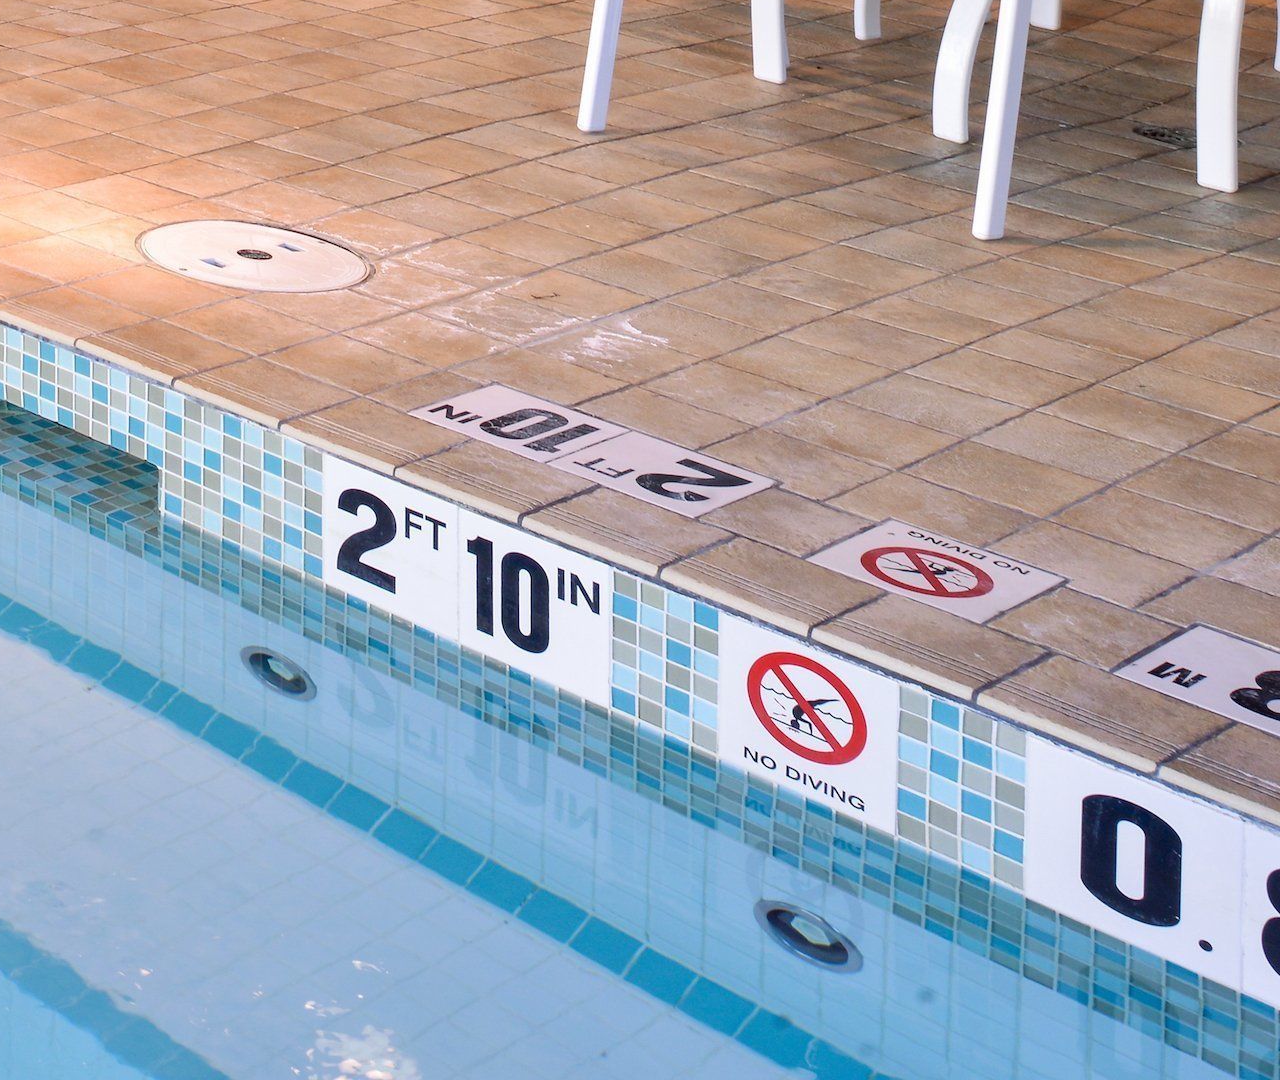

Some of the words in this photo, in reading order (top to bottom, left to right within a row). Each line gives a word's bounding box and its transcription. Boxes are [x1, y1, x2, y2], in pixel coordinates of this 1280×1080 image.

[906, 530, 987, 561] DIVING
[993, 560, 1031, 576] NO
[743, 745, 777, 770] NO
[785, 765, 866, 812] DIVING
[1080, 793, 1280, 977] 0.
